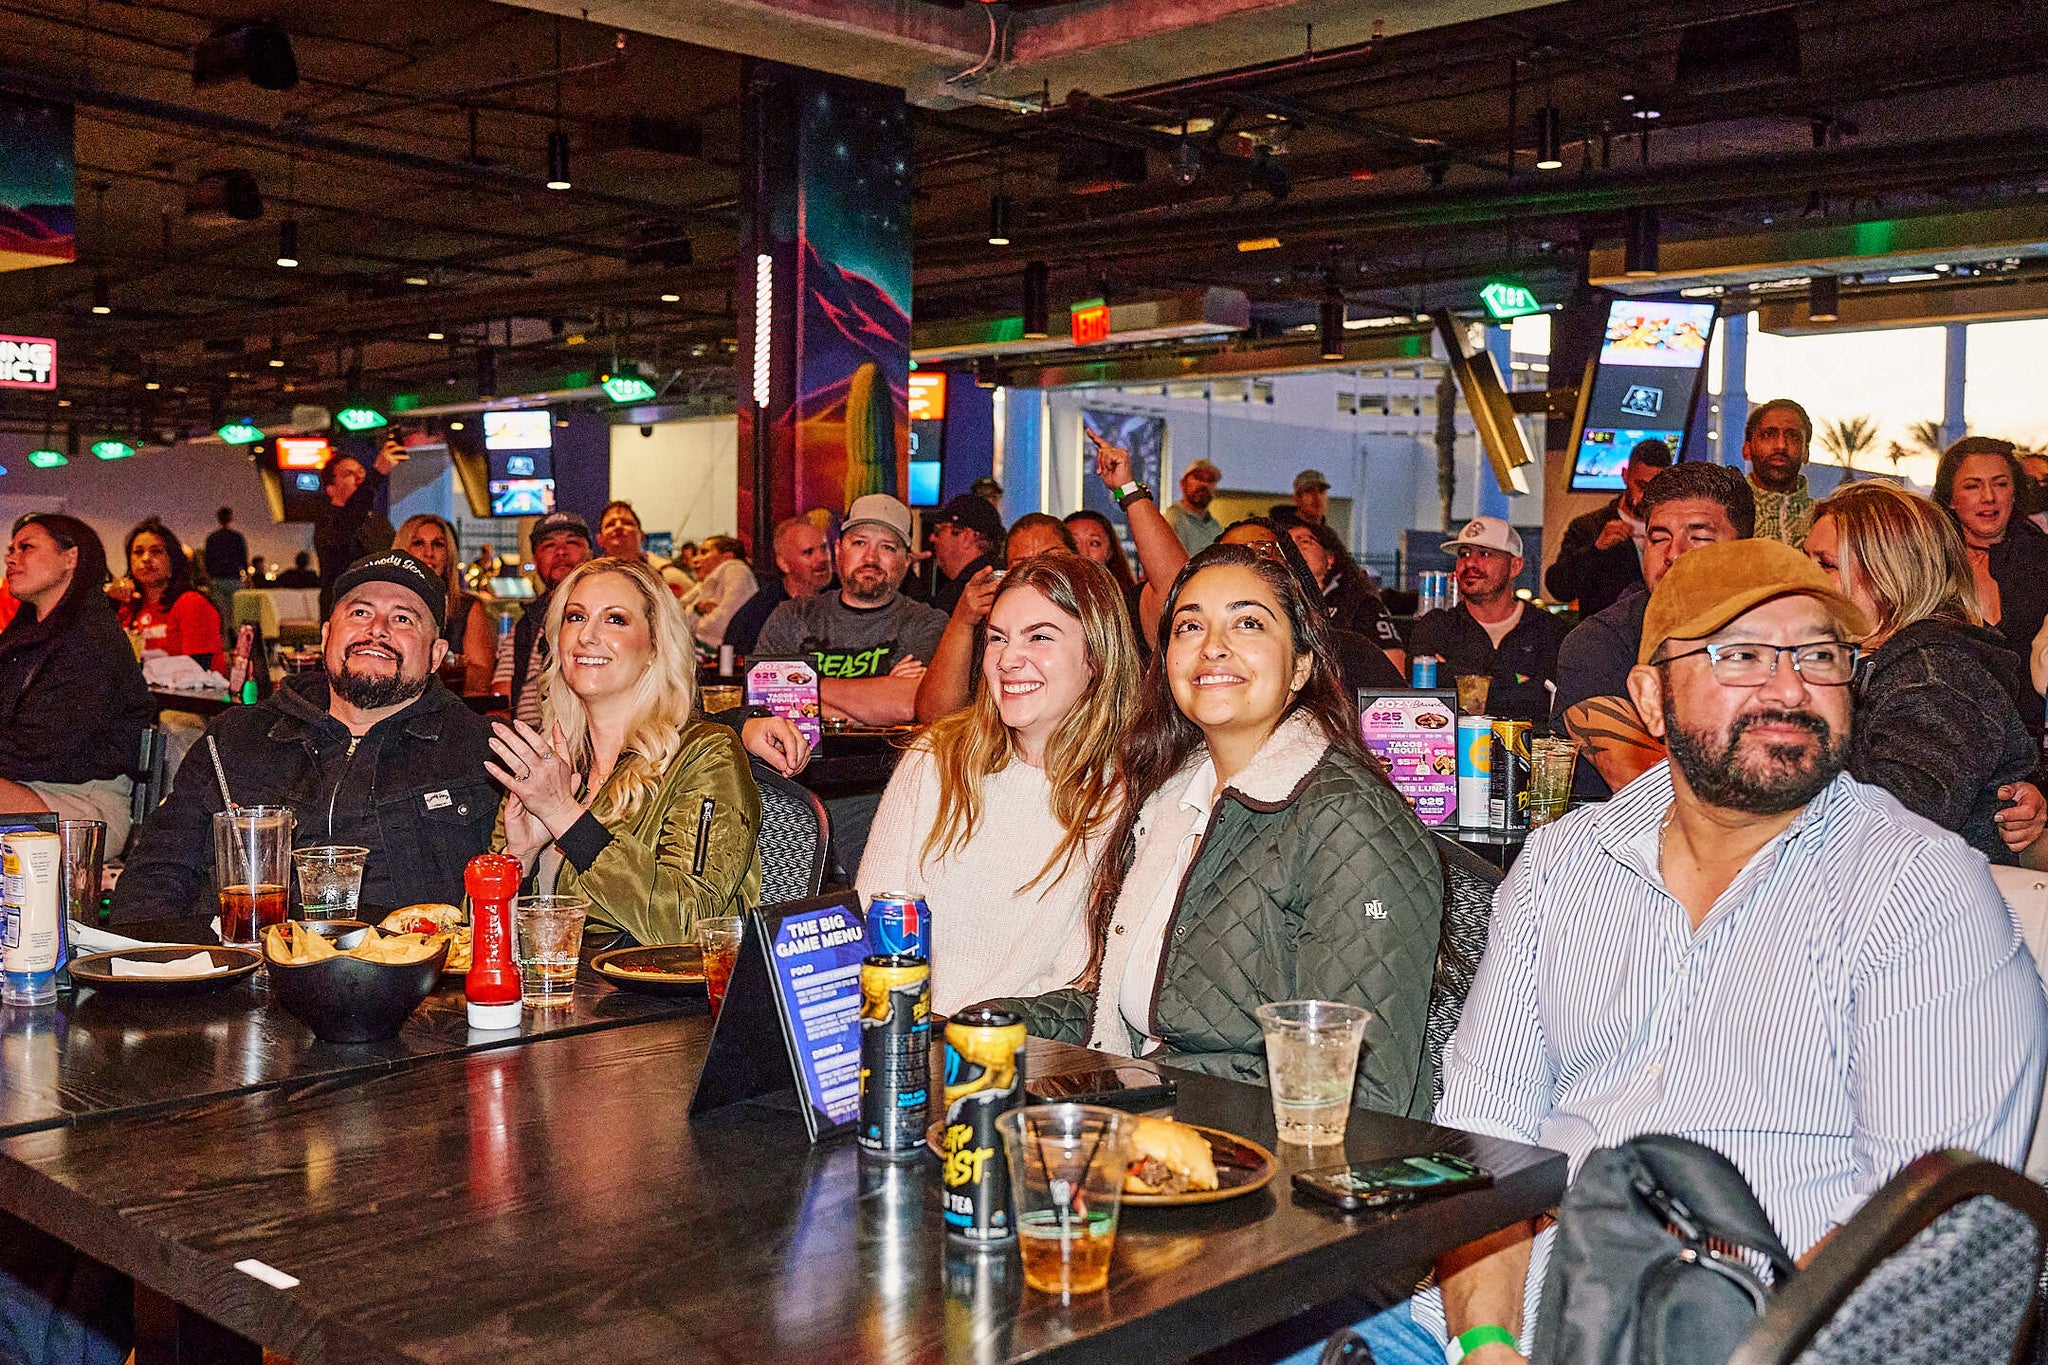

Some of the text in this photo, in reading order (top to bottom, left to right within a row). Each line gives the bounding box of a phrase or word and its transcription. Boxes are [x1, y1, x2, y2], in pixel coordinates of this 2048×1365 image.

[1078, 309, 1104, 340] EXIT
[0, 341, 51, 365] ING
[0, 361, 50, 382] ICT
[1371, 711, 1402, 721] $25
[1386, 747, 1431, 755] TEQUILA
[1418, 797, 1445, 806] $25
[786, 914, 846, 939] THE BIG
[776, 926, 863, 958] GAME MENU
